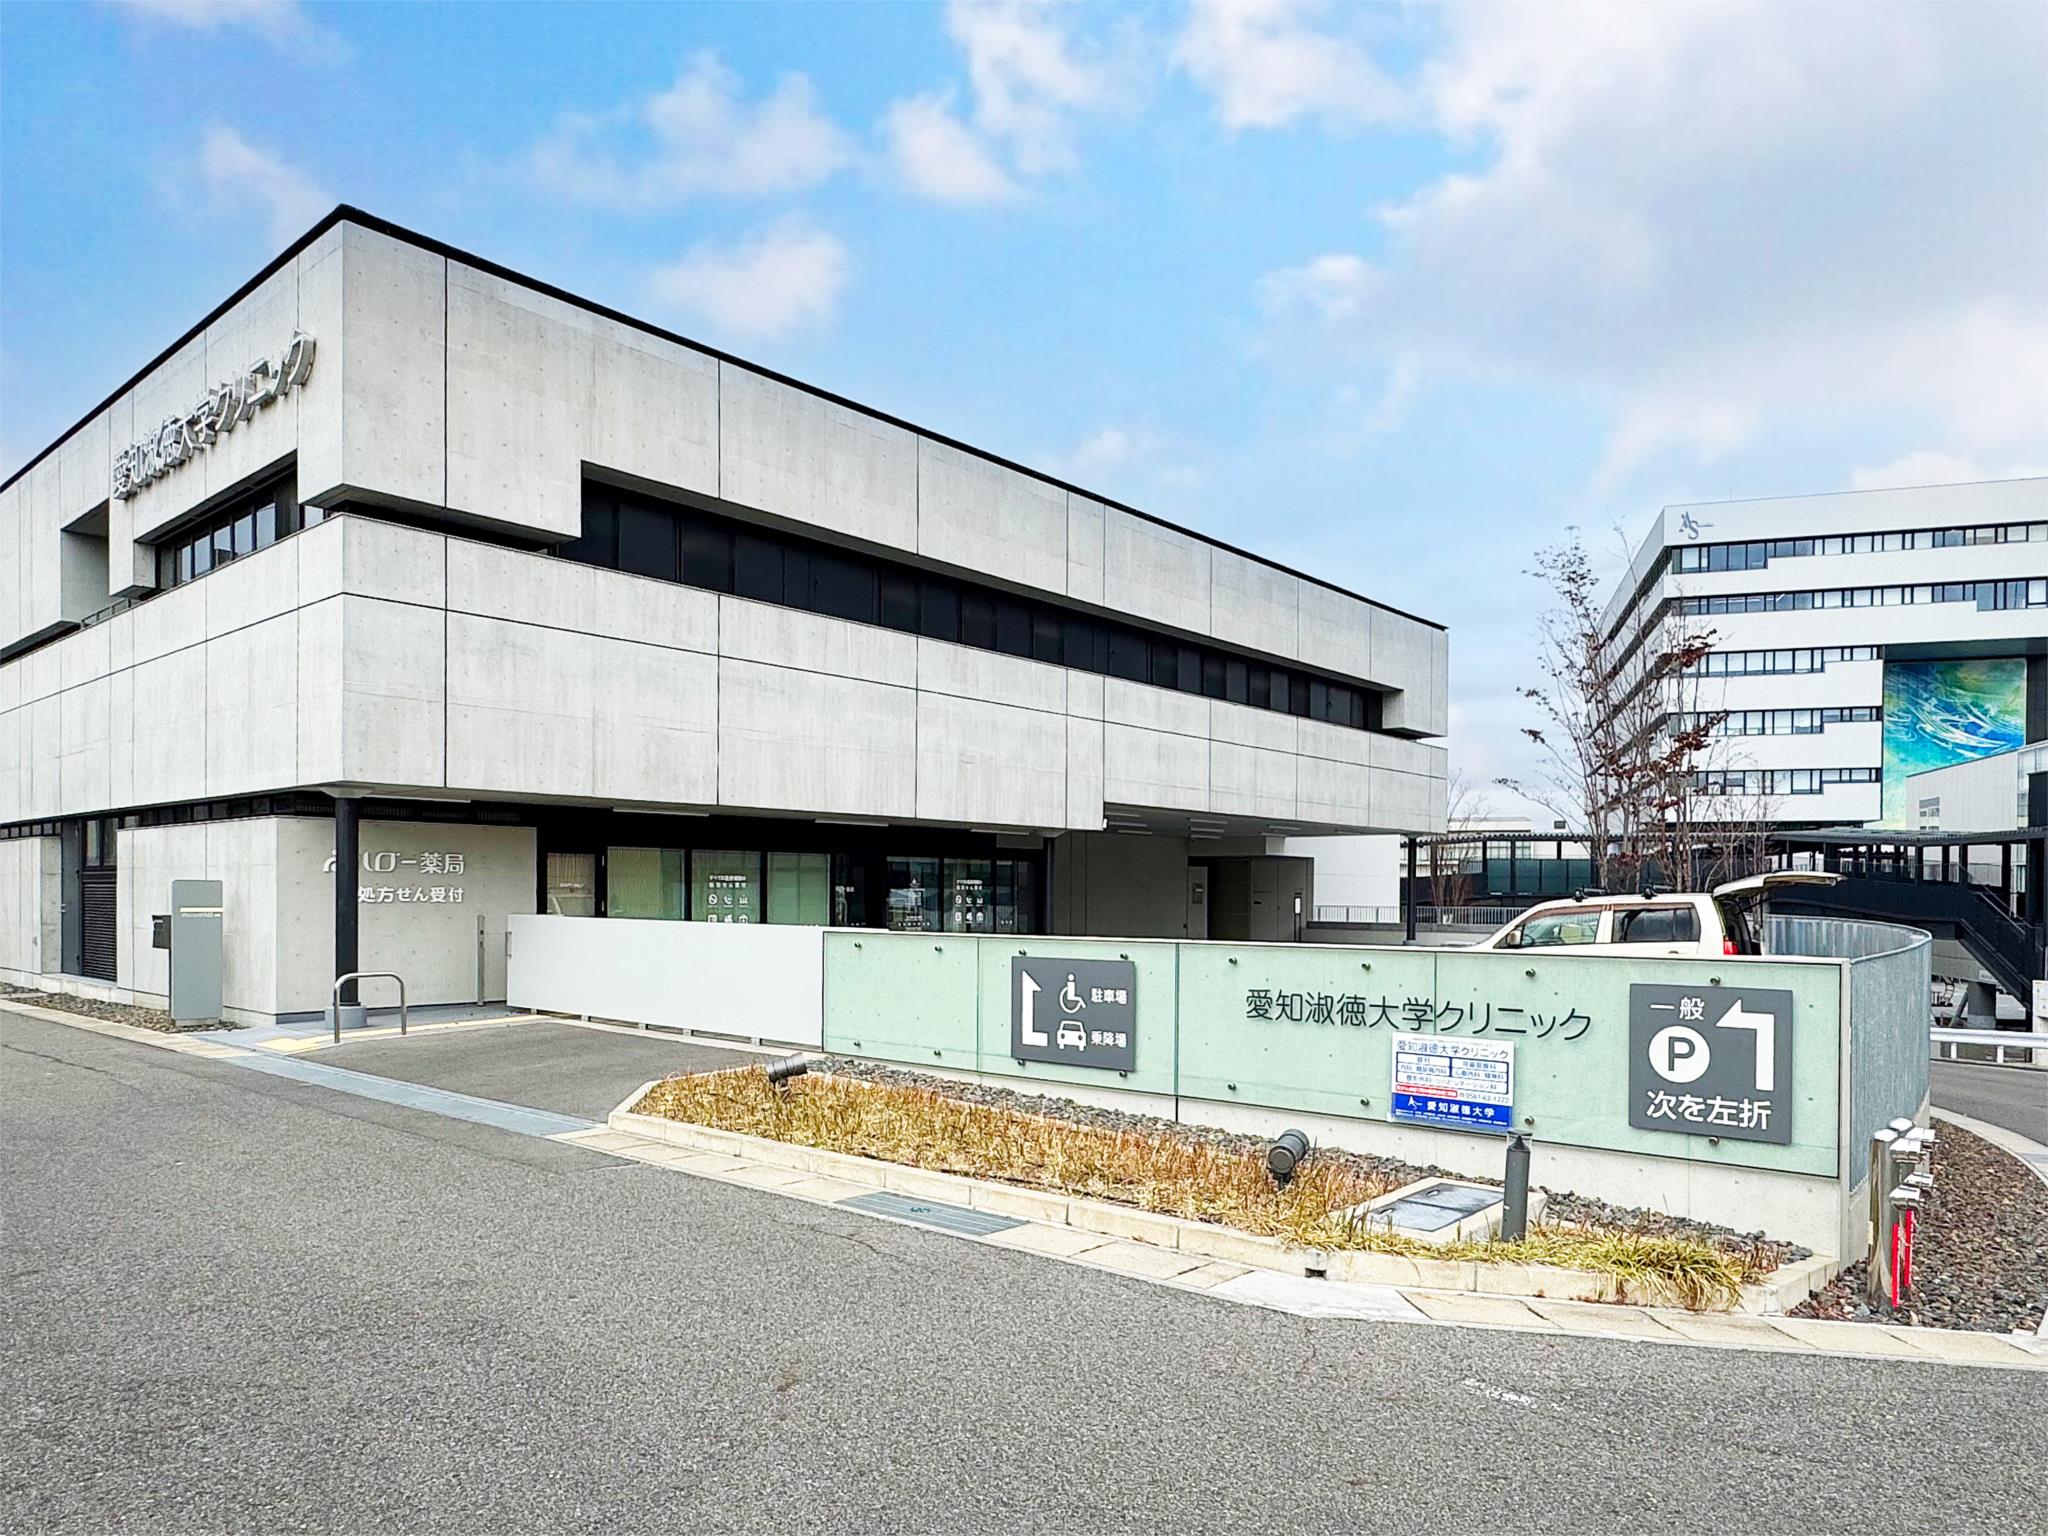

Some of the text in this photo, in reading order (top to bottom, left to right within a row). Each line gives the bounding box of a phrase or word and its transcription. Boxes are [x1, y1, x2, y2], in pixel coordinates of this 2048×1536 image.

[358, 886, 465, 903] 処方せん受付
[1090, 988, 1128, 1005] 駐車場
[1246, 988, 1592, 1041] 愛知淑徳大学クリニック
[1649, 996, 1705, 1021] 一般
[1090, 1031, 1127, 1048] 乗降場
[1667, 1036, 1696, 1072] P
[1426, 1100, 1495, 1118] 愛知淑徳大学
[1646, 1090, 1772, 1130] 次を左折
